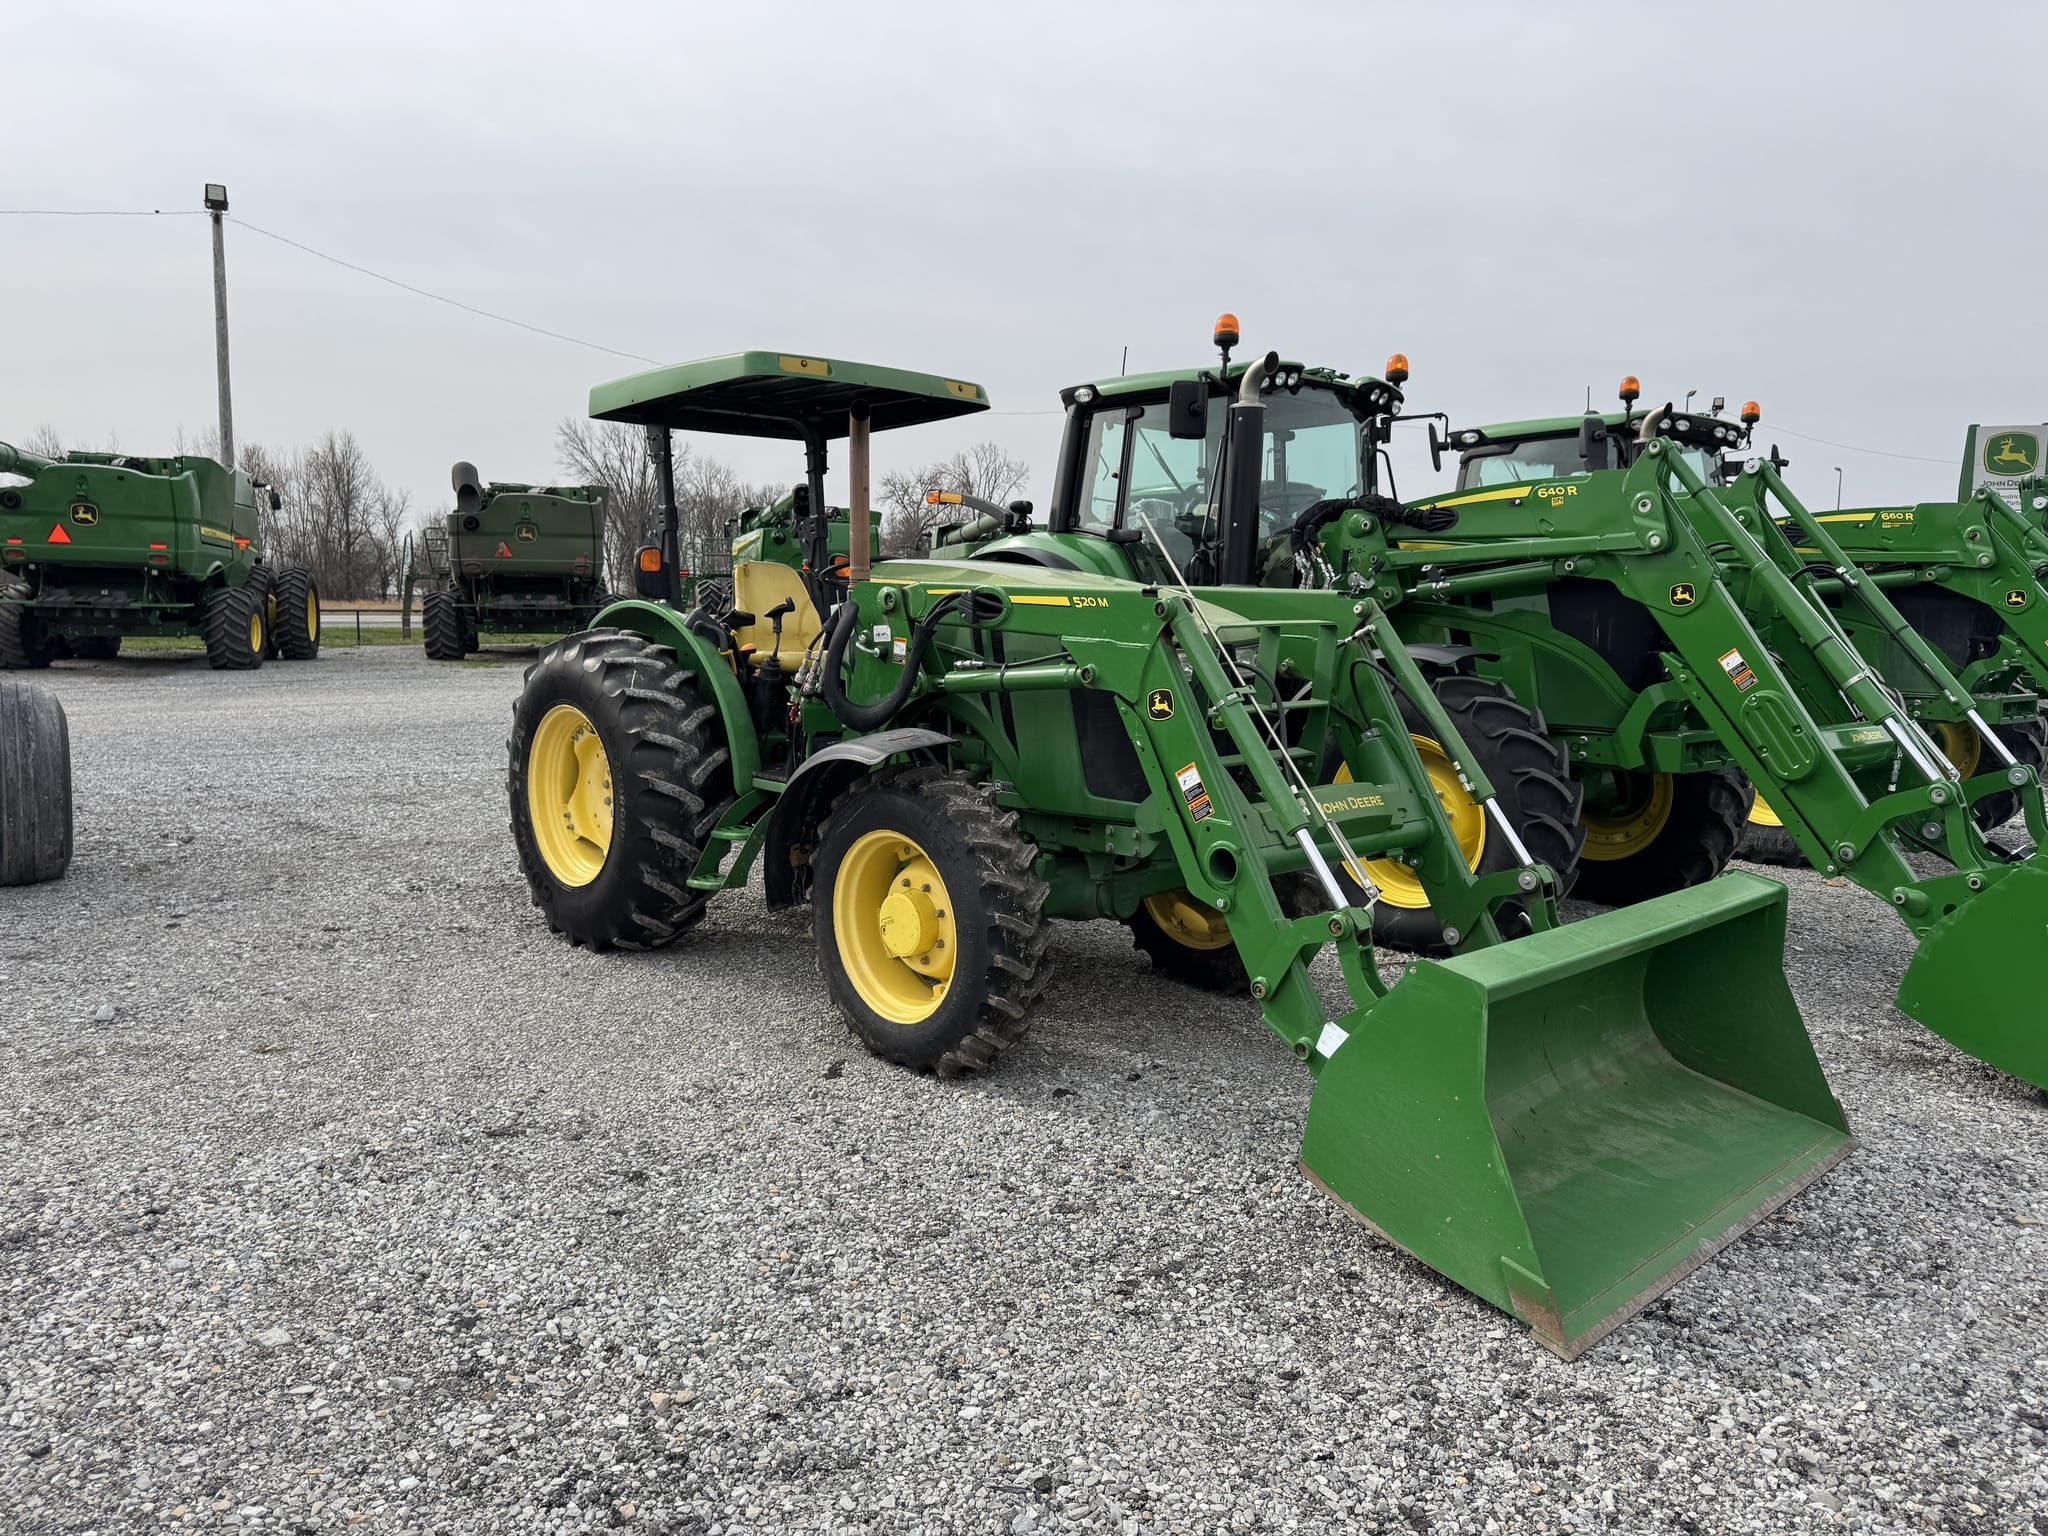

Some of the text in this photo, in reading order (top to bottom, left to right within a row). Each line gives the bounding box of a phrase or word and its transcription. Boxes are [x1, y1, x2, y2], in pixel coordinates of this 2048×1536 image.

[1537, 486, 1578, 498] 640 R
[1881, 512, 1914, 520] 660 R
[1072, 596, 1109, 608] 520 M
[1347, 795, 1385, 809] DEERE
